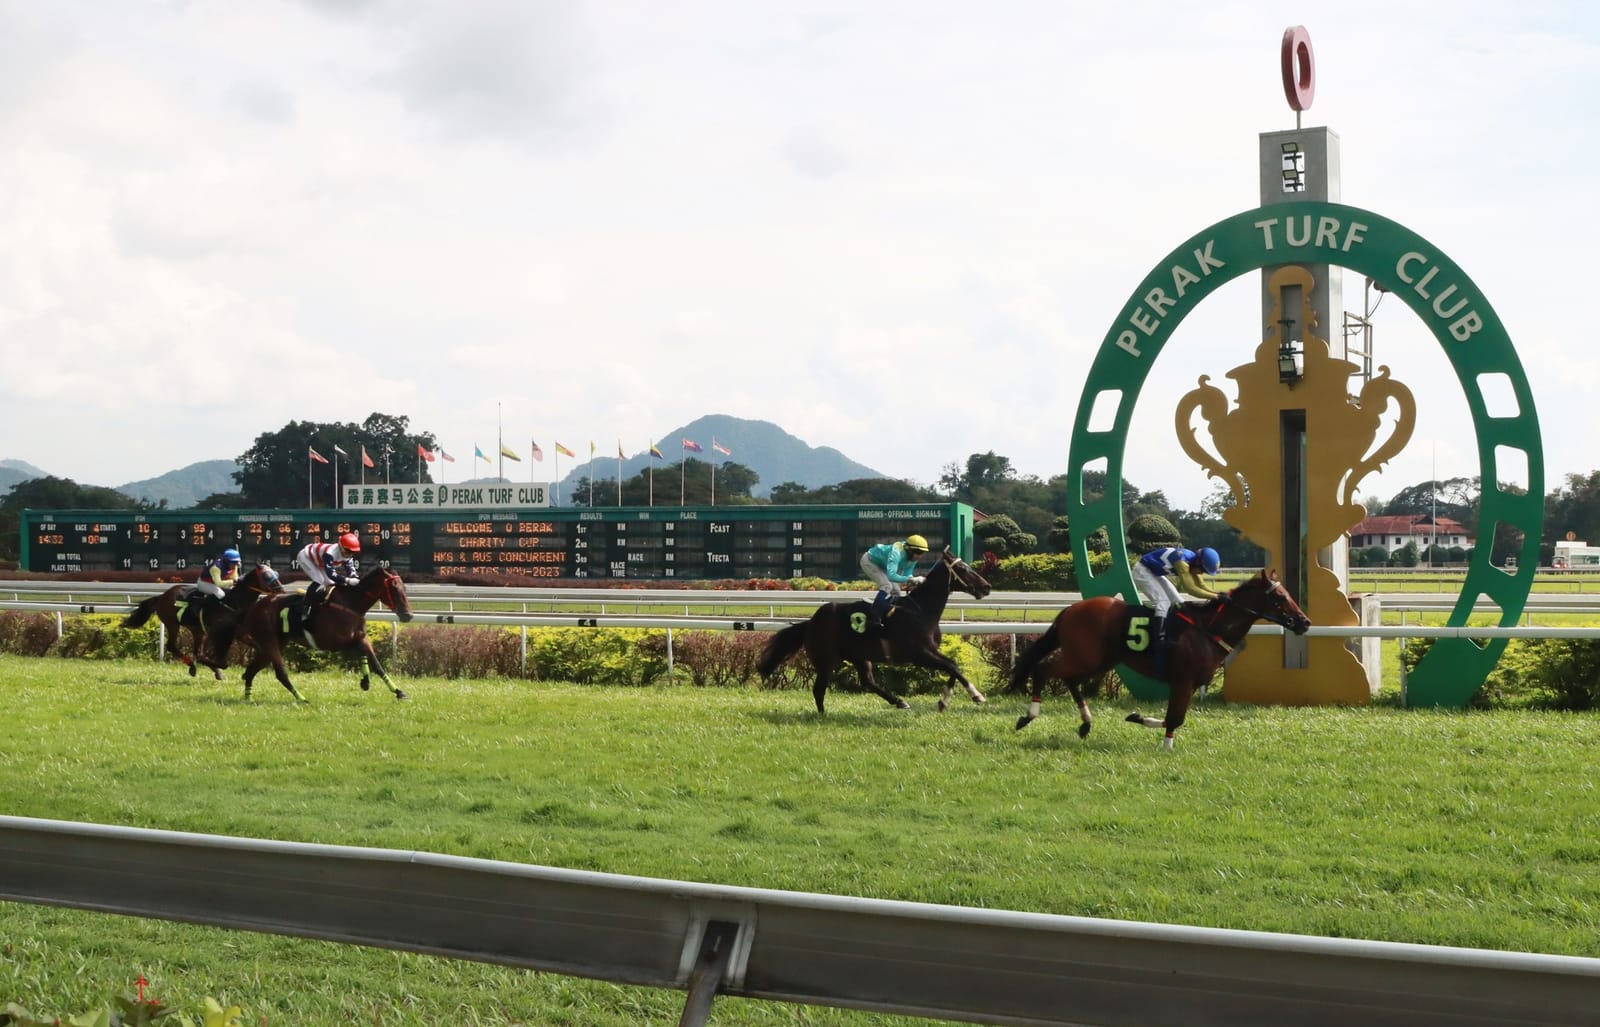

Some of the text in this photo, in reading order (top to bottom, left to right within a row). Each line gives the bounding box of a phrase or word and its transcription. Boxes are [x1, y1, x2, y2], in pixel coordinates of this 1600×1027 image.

[1115, 215, 1483, 358] PERAK TURF CLUB
[452, 487, 544, 504] PERAK TURF CLUB
[580, 512, 603, 520] RESULTS
[680, 512, 697, 520] PLACE
[446, 522, 493, 533] WELCOME
[519, 522, 553, 533] PERAK
[665, 522, 674, 531] RM
[126, 529, 131, 539] 1
[153, 530, 159, 539] 2
[180, 530, 186, 539] 3
[208, 530, 214, 539] 4
[236, 530, 242, 539] 5
[265, 530, 271, 540] 6
[294, 530, 301, 540] 7
[324, 530, 330, 540] 8
[381, 530, 391, 540] 10
[193, 535, 205, 545] 21
[279, 535, 292, 545] 12
[459, 537, 506, 548] CHARITY
[499, 552, 566, 562] CONCURRENT
[627, 553, 644, 561] RACE
[51, 564, 82, 572] PLACE TOTAL
[123, 558, 131, 568] 11
[150, 559, 159, 568] 12
[177, 559, 186, 568] 13
[610, 561, 626, 569] RACE
[174, 600, 190, 622] 7
[280, 607, 290, 633] 1
[1126, 616, 1150, 651] 5
